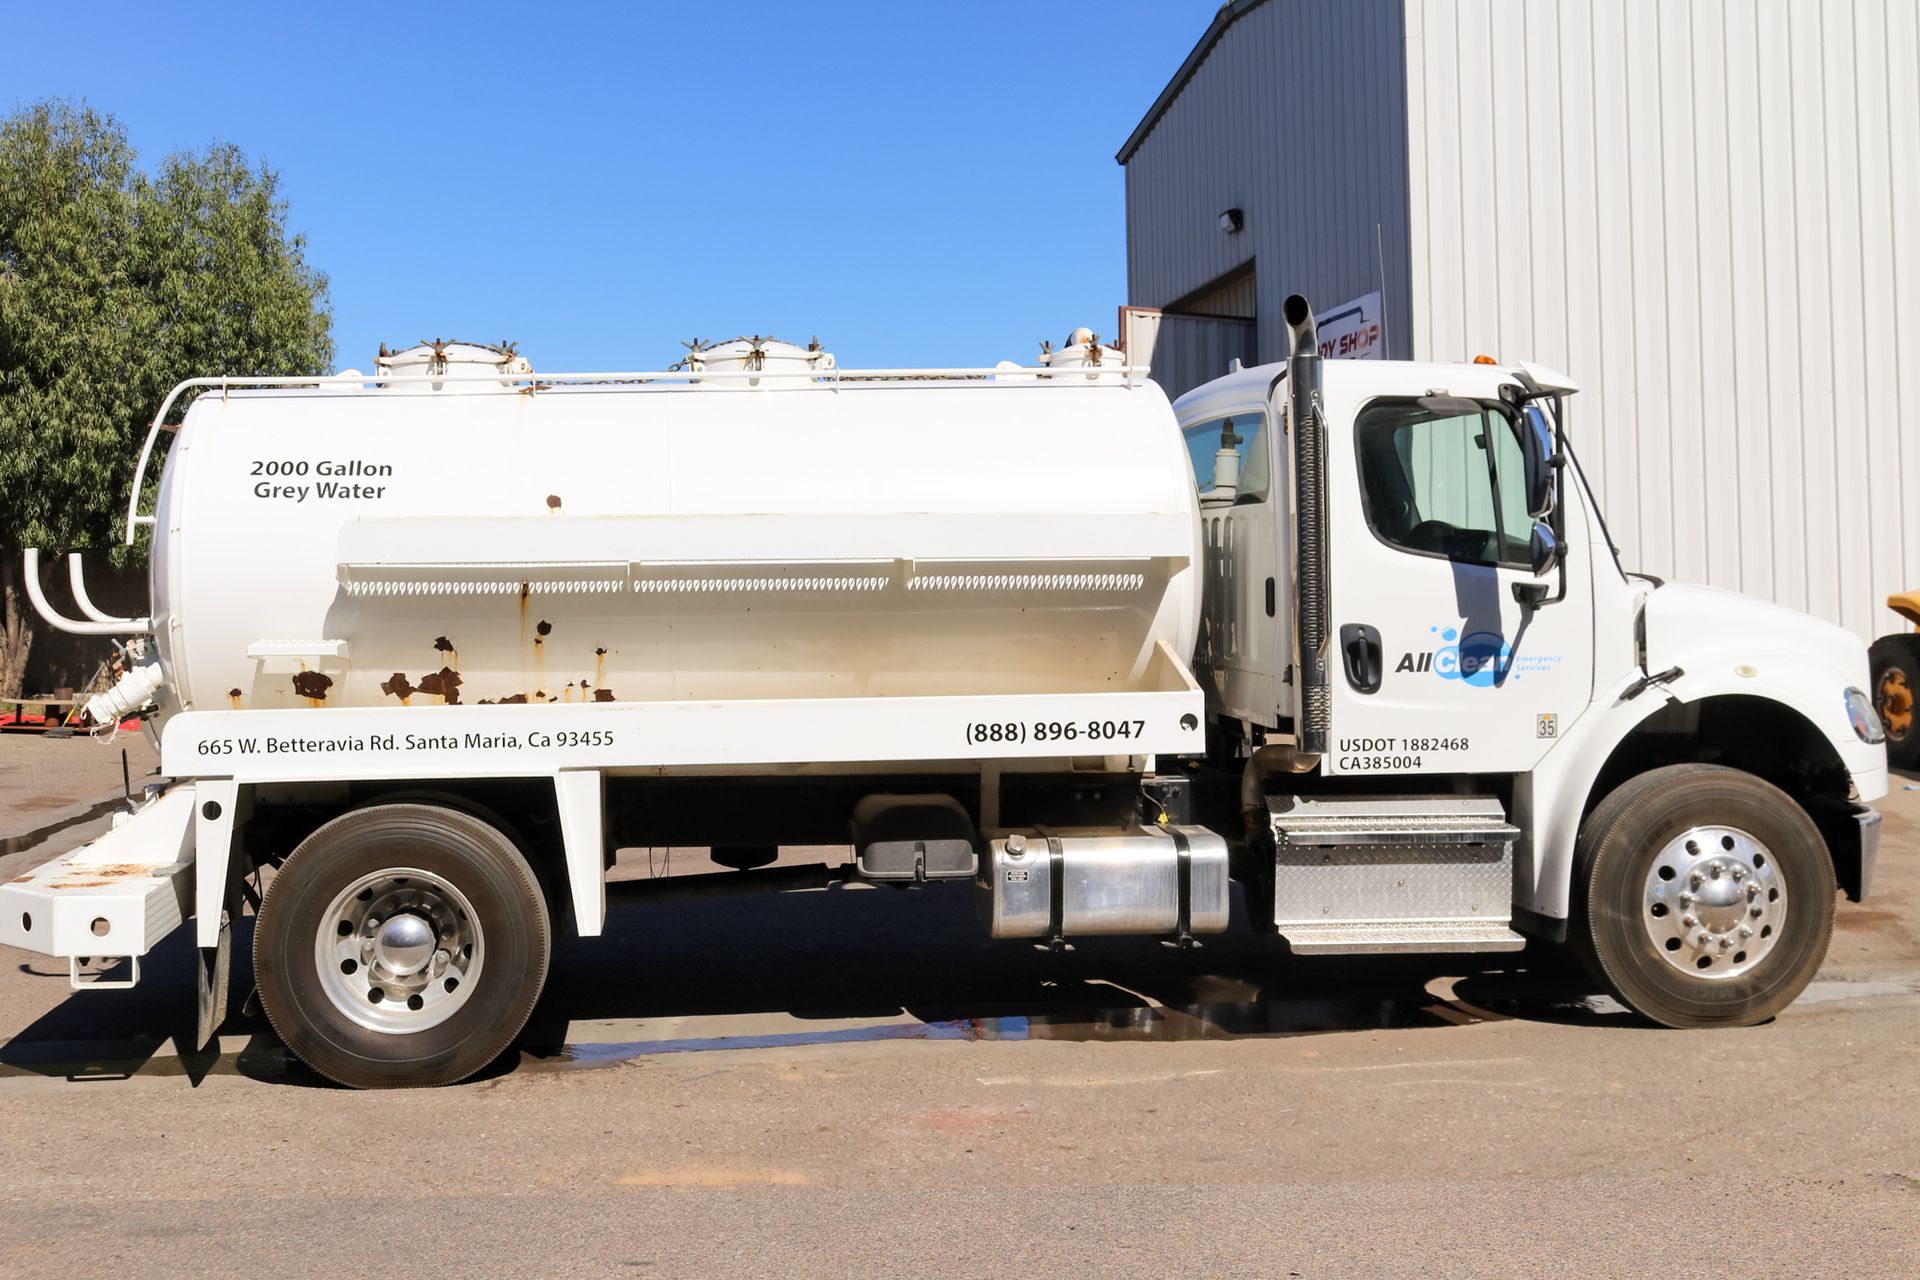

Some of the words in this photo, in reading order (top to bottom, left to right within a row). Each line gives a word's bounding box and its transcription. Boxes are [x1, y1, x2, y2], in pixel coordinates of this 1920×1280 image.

[1318, 338, 1337, 359] DY
[1339, 324, 1379, 356] SHOP
[250, 460, 309, 476] 2000
[315, 460, 393, 477] Gallon
[253, 481, 310, 503] Grey
[316, 482, 386, 499] Water
[1515, 655, 1562, 664] Emergency
[1515, 664, 1551, 672] Services
[966, 721, 1026, 746] (888)
[1033, 720, 1145, 741] 896-8047
[1539, 720, 1555, 736] 35
[197, 739, 233, 756] 665
[238, 738, 261, 754] W.
[266, 735, 364, 754] Betteravia
[370, 734, 400, 751] Rd.
[405, 734, 458, 750] Santa
[464, 732, 523, 750] Maria,
[528, 731, 551, 748] Ca
[556, 730, 614, 747] 93455
[1339, 738, 1397, 753] USDOT
[1402, 737, 1469, 752] 1882468
[1339, 755, 1422, 771] CA385004
